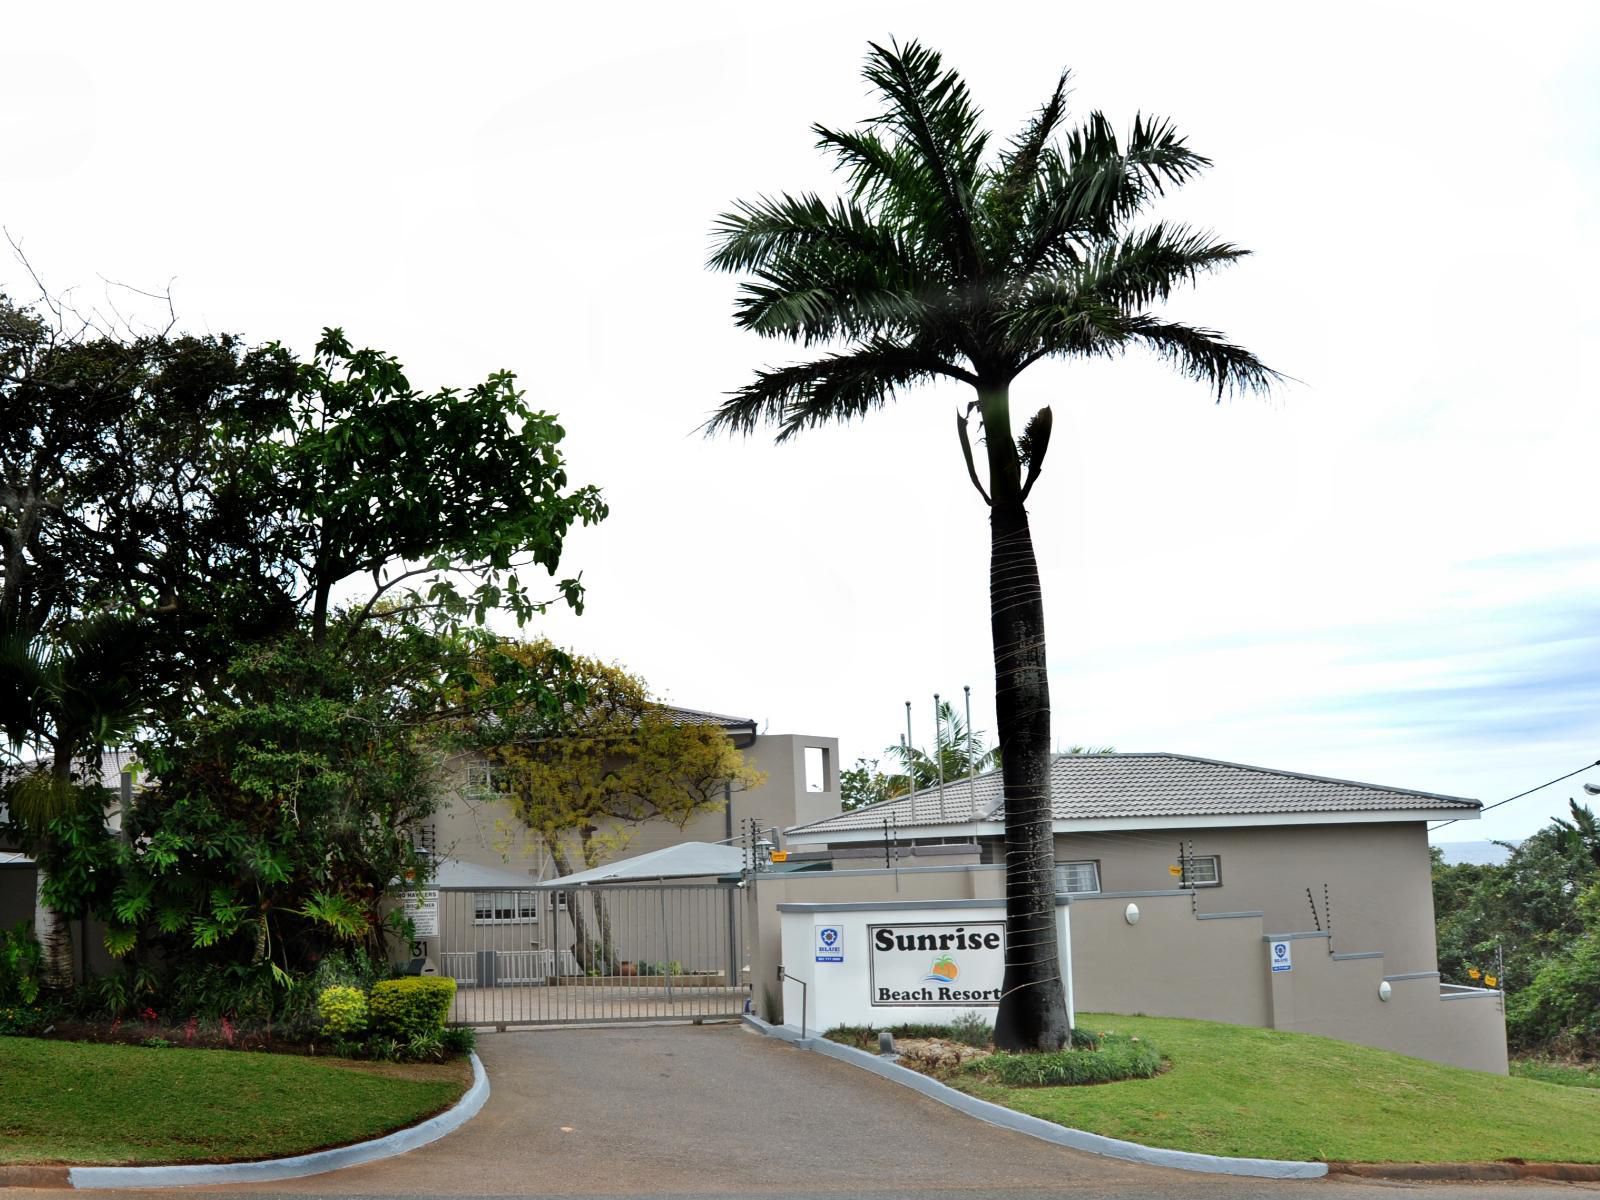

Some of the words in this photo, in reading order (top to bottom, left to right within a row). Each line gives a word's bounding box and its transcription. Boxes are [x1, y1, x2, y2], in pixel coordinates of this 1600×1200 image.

[875, 927, 1000, 951] Sunrise
[412, 941, 427, 957] 31
[878, 987, 933, 1001] Beach
[938, 987, 1001, 1001] Resort
